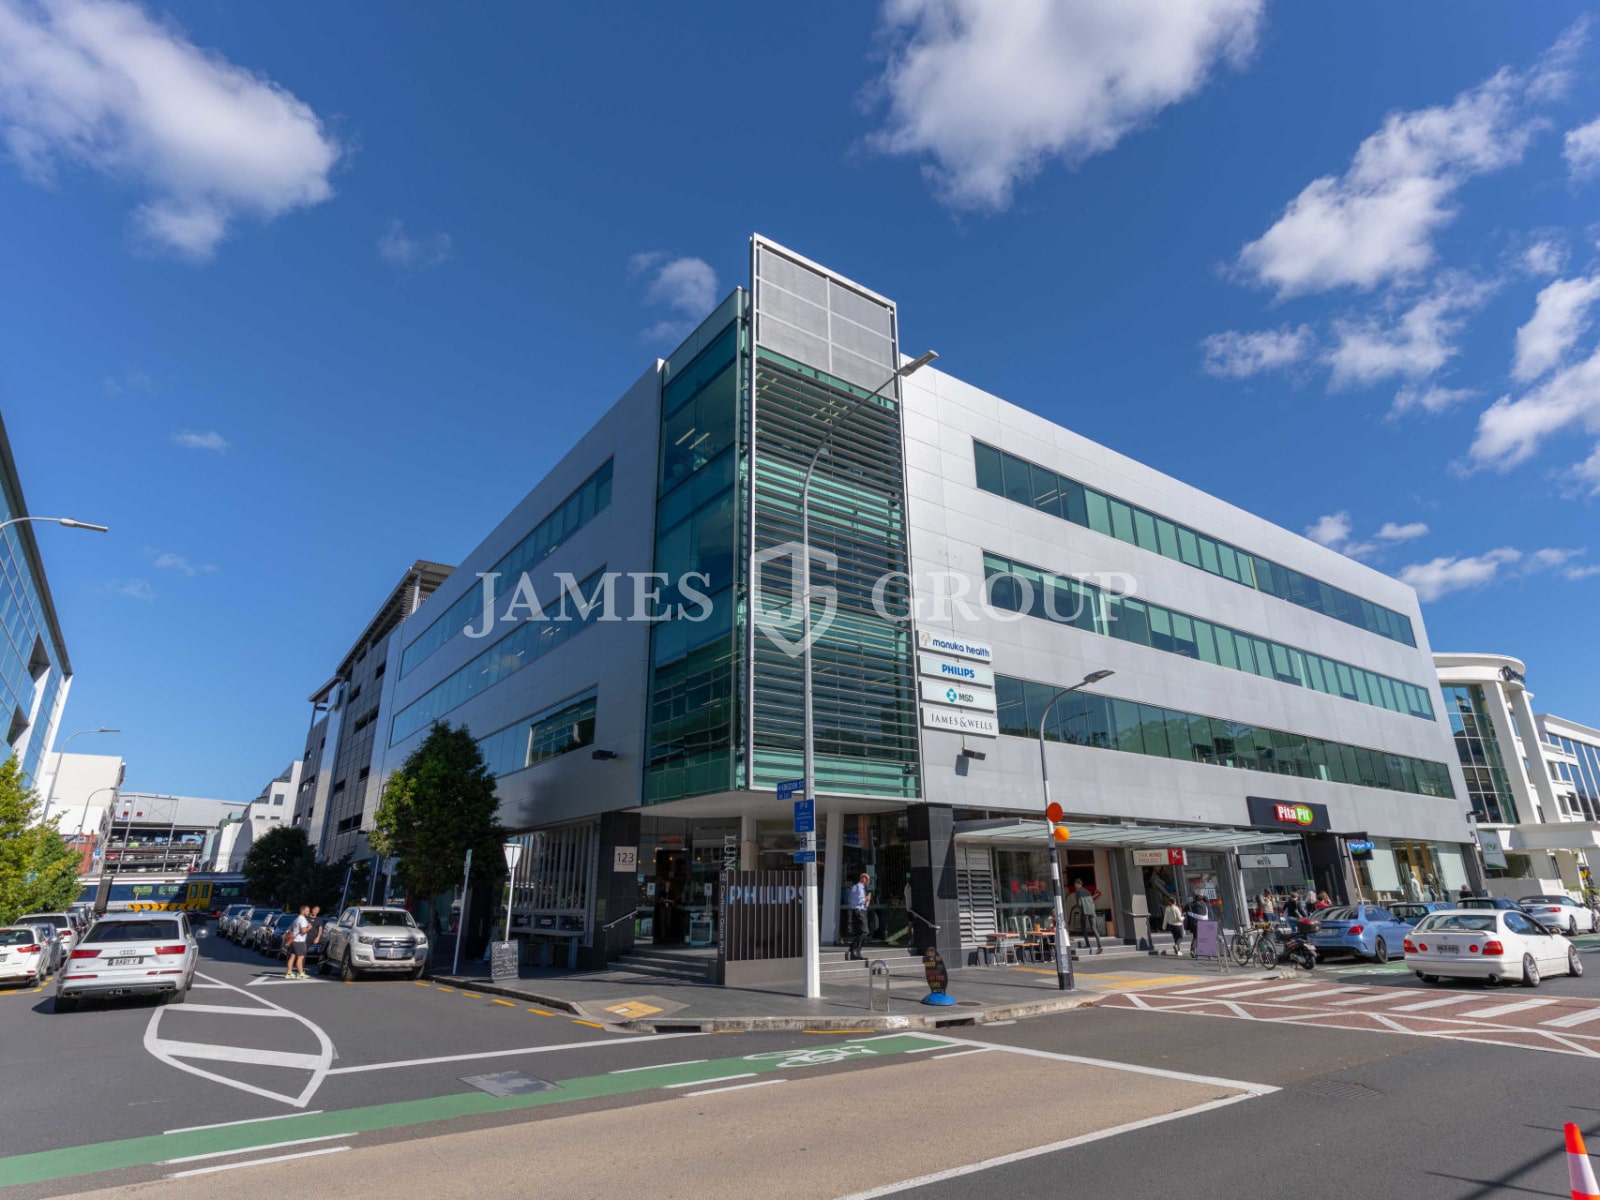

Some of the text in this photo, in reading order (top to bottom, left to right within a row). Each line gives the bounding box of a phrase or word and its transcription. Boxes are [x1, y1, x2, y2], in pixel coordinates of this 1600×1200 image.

[932, 638, 990, 657] manuka health
[941, 663, 975, 678] PHILIPS
[958, 693, 974, 702] MSD
[1277, 805, 1310, 820] Pita Pit
[617, 852, 634, 863] 123
